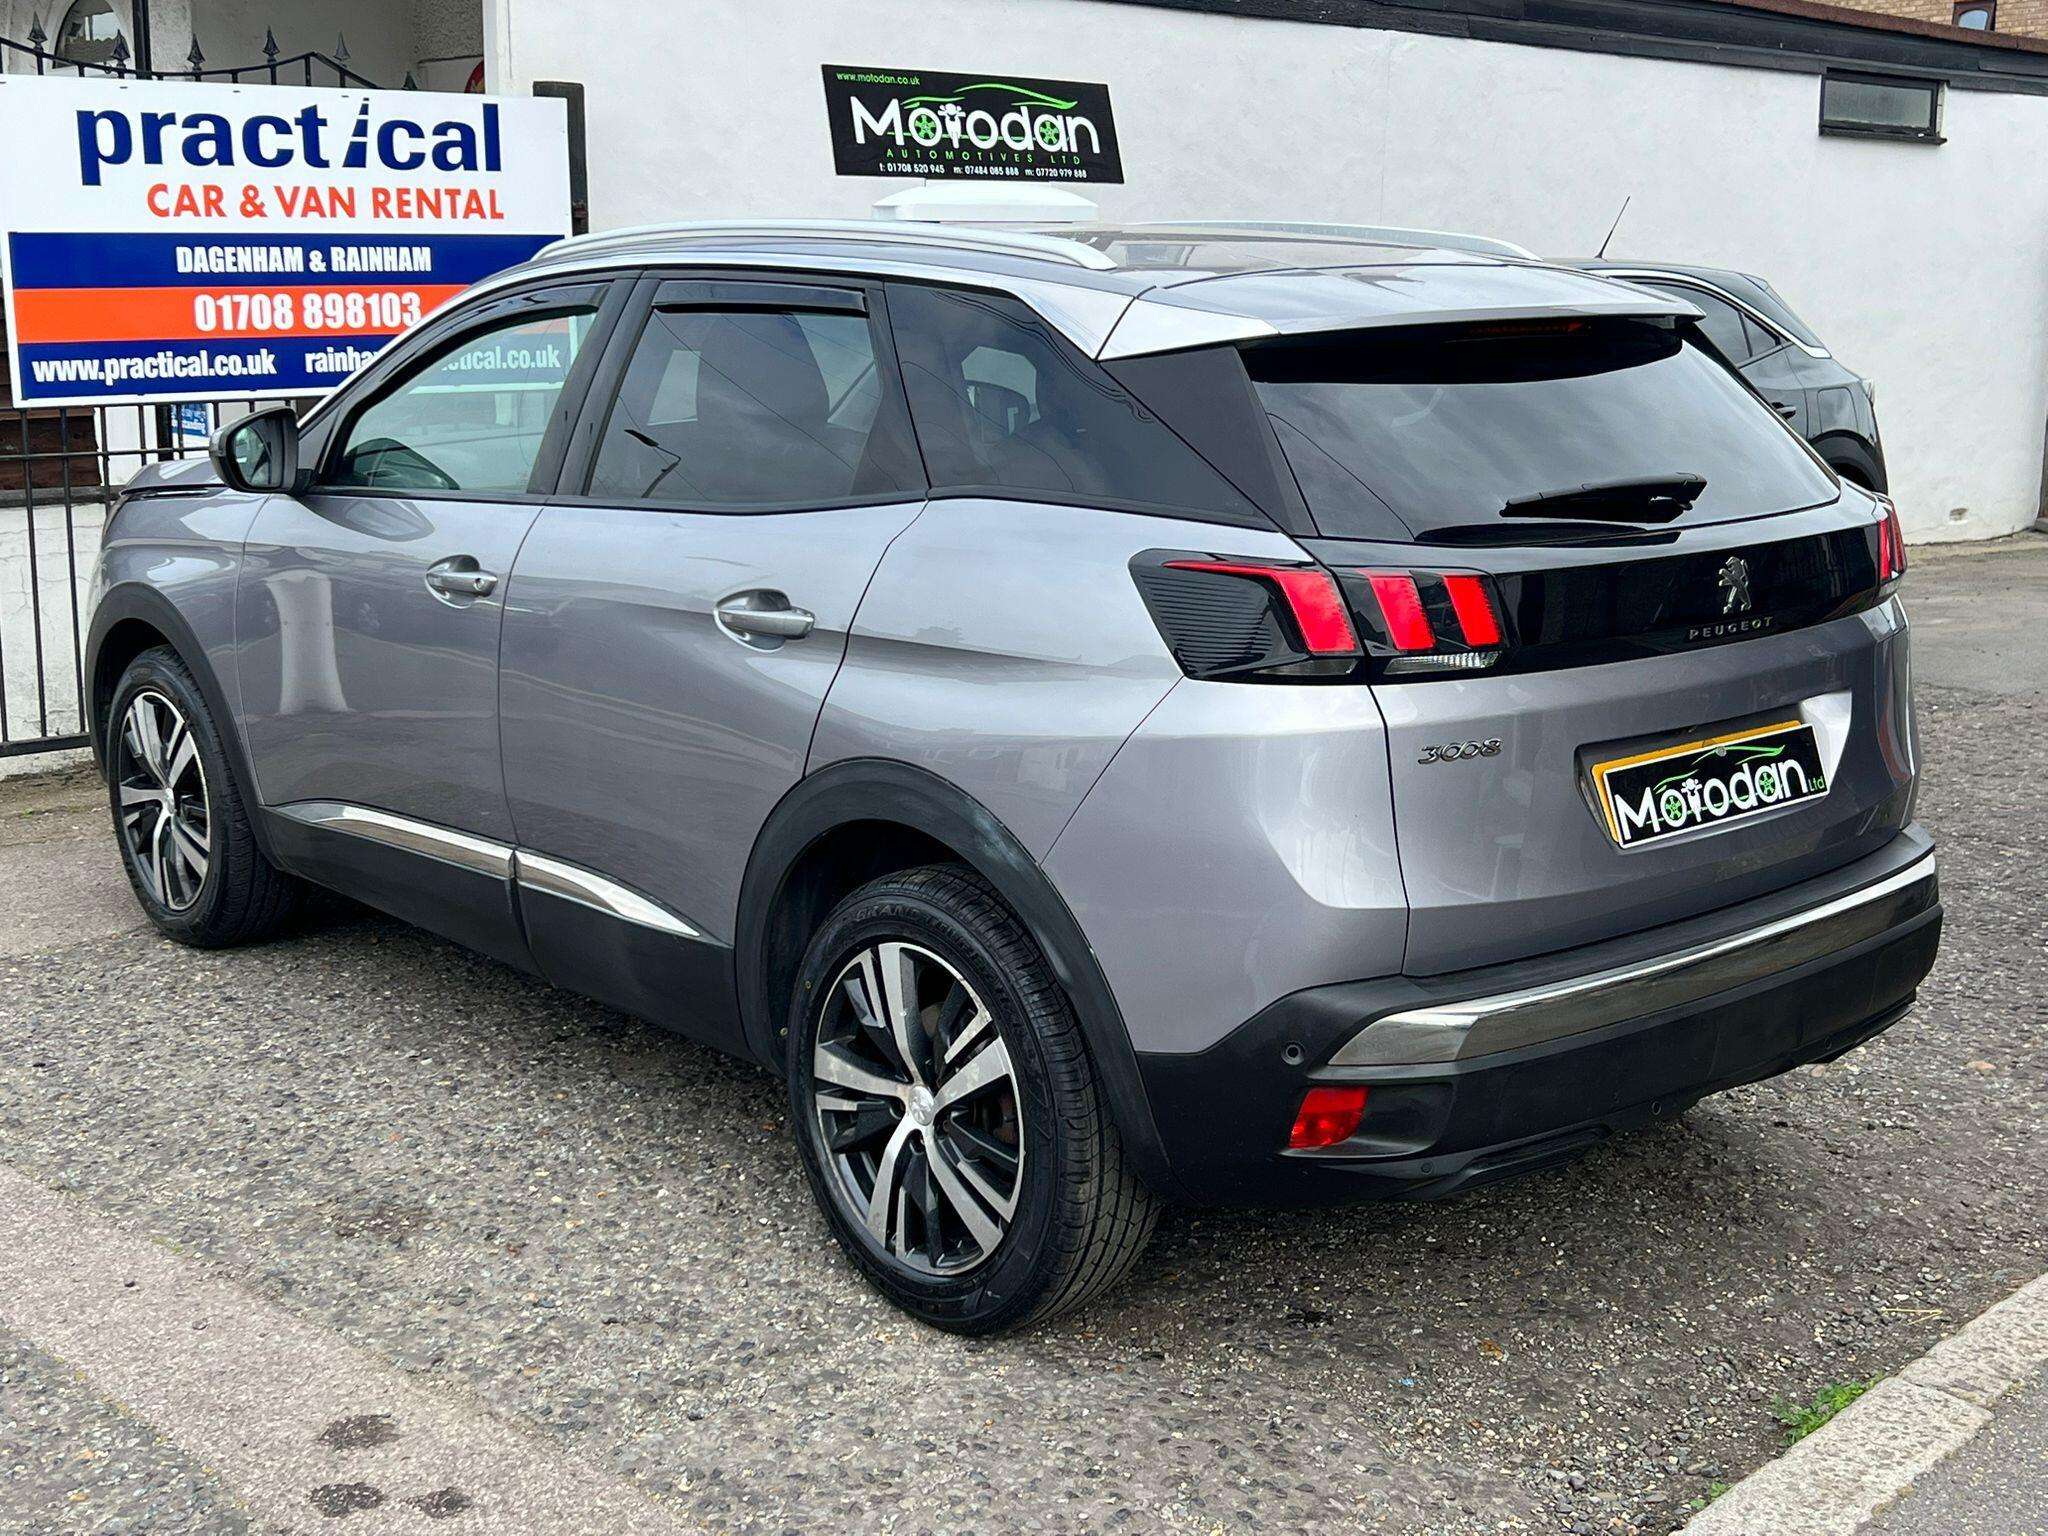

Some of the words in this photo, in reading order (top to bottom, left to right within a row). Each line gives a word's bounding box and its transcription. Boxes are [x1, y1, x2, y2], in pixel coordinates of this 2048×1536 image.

[836, 71, 921, 86] www.motodan.co.uk
[849, 95, 1101, 154] Motodan
[76, 97, 502, 186] practical
[886, 148, 1033, 163] AUTOMOTIVES
[1049, 155, 1081, 165] LTD
[879, 162, 886, 172] t:
[887, 163, 912, 172] 01708
[913, 164, 929, 173] 520
[929, 164, 945, 174] 945
[147, 183, 223, 218] CAR
[239, 185, 268, 218] &
[274, 185, 356, 219] VAN
[373, 187, 504, 220] RENTAL
[176, 245, 304, 273] DAGENHAM
[309, 251, 327, 273] &
[332, 246, 432, 272] RAINHAM
[193, 293, 295, 332] 01708
[303, 292, 423, 329] 898103
[31, 348, 277, 386] www.practical.co.uk
[1689, 616, 1774, 640] PEUGEOT
[1417, 738, 1502, 764] 3008
[1614, 758, 1809, 840] Motodan
[1808, 775, 1826, 792] Ltd
